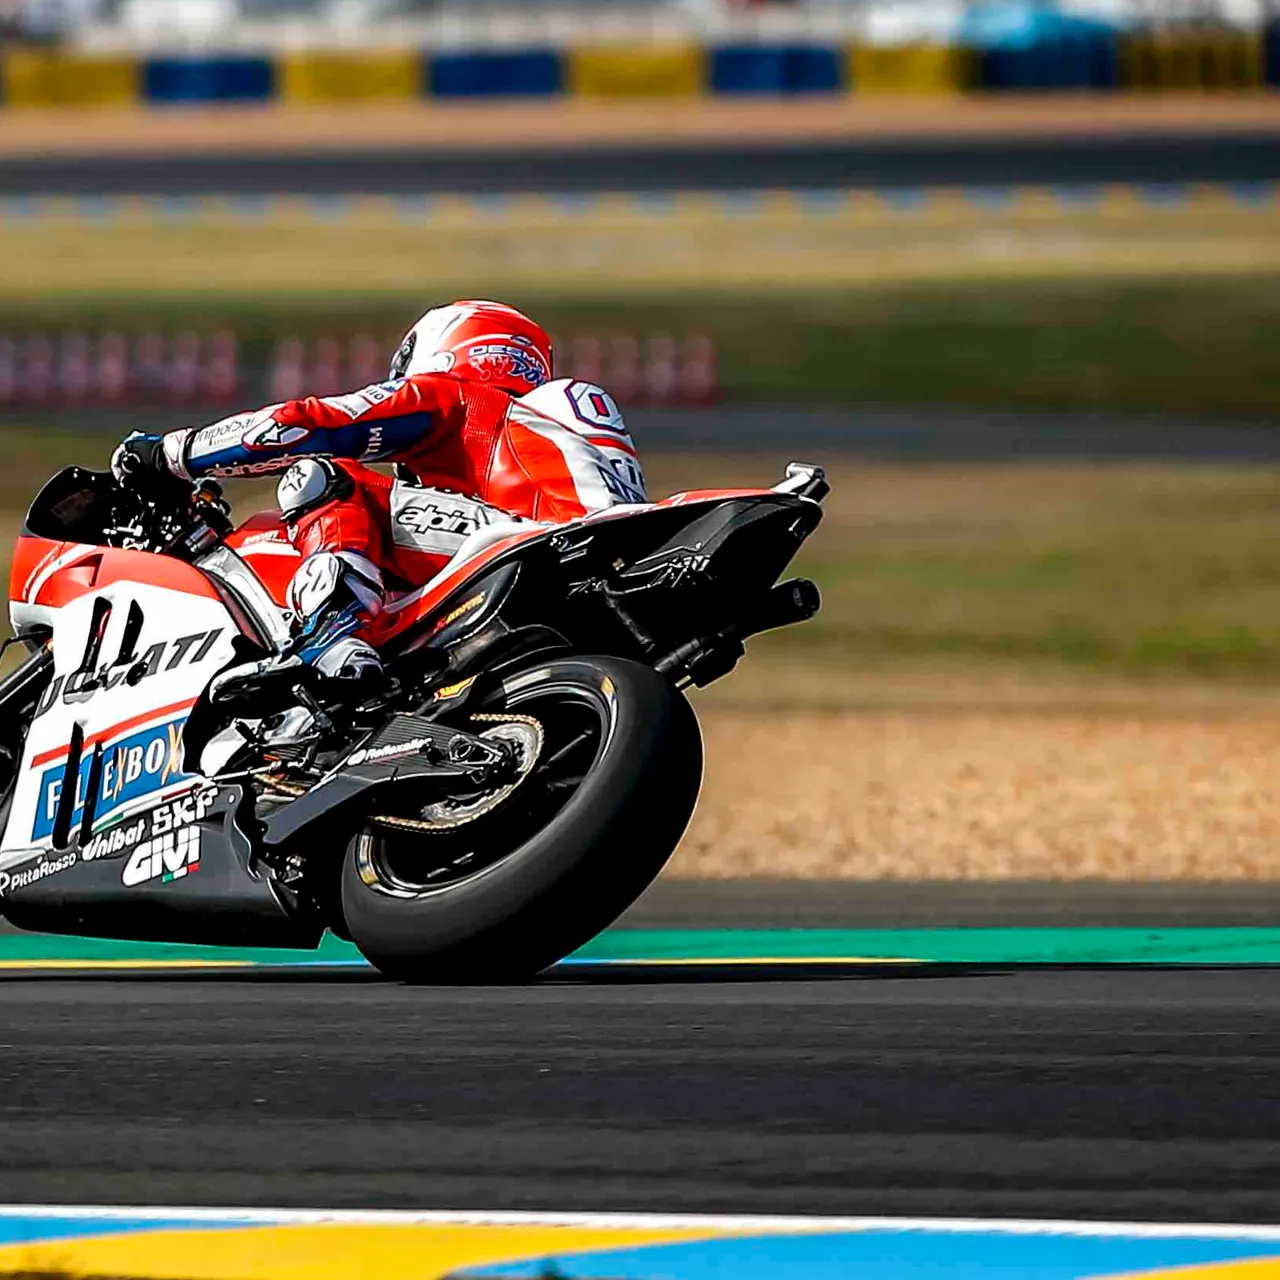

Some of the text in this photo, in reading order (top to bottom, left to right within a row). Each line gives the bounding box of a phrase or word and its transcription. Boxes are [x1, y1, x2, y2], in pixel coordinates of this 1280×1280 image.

[152, 786, 219, 833] SKF
[83, 819, 144, 862] Unibat
[122, 825, 202, 888] GIVI
